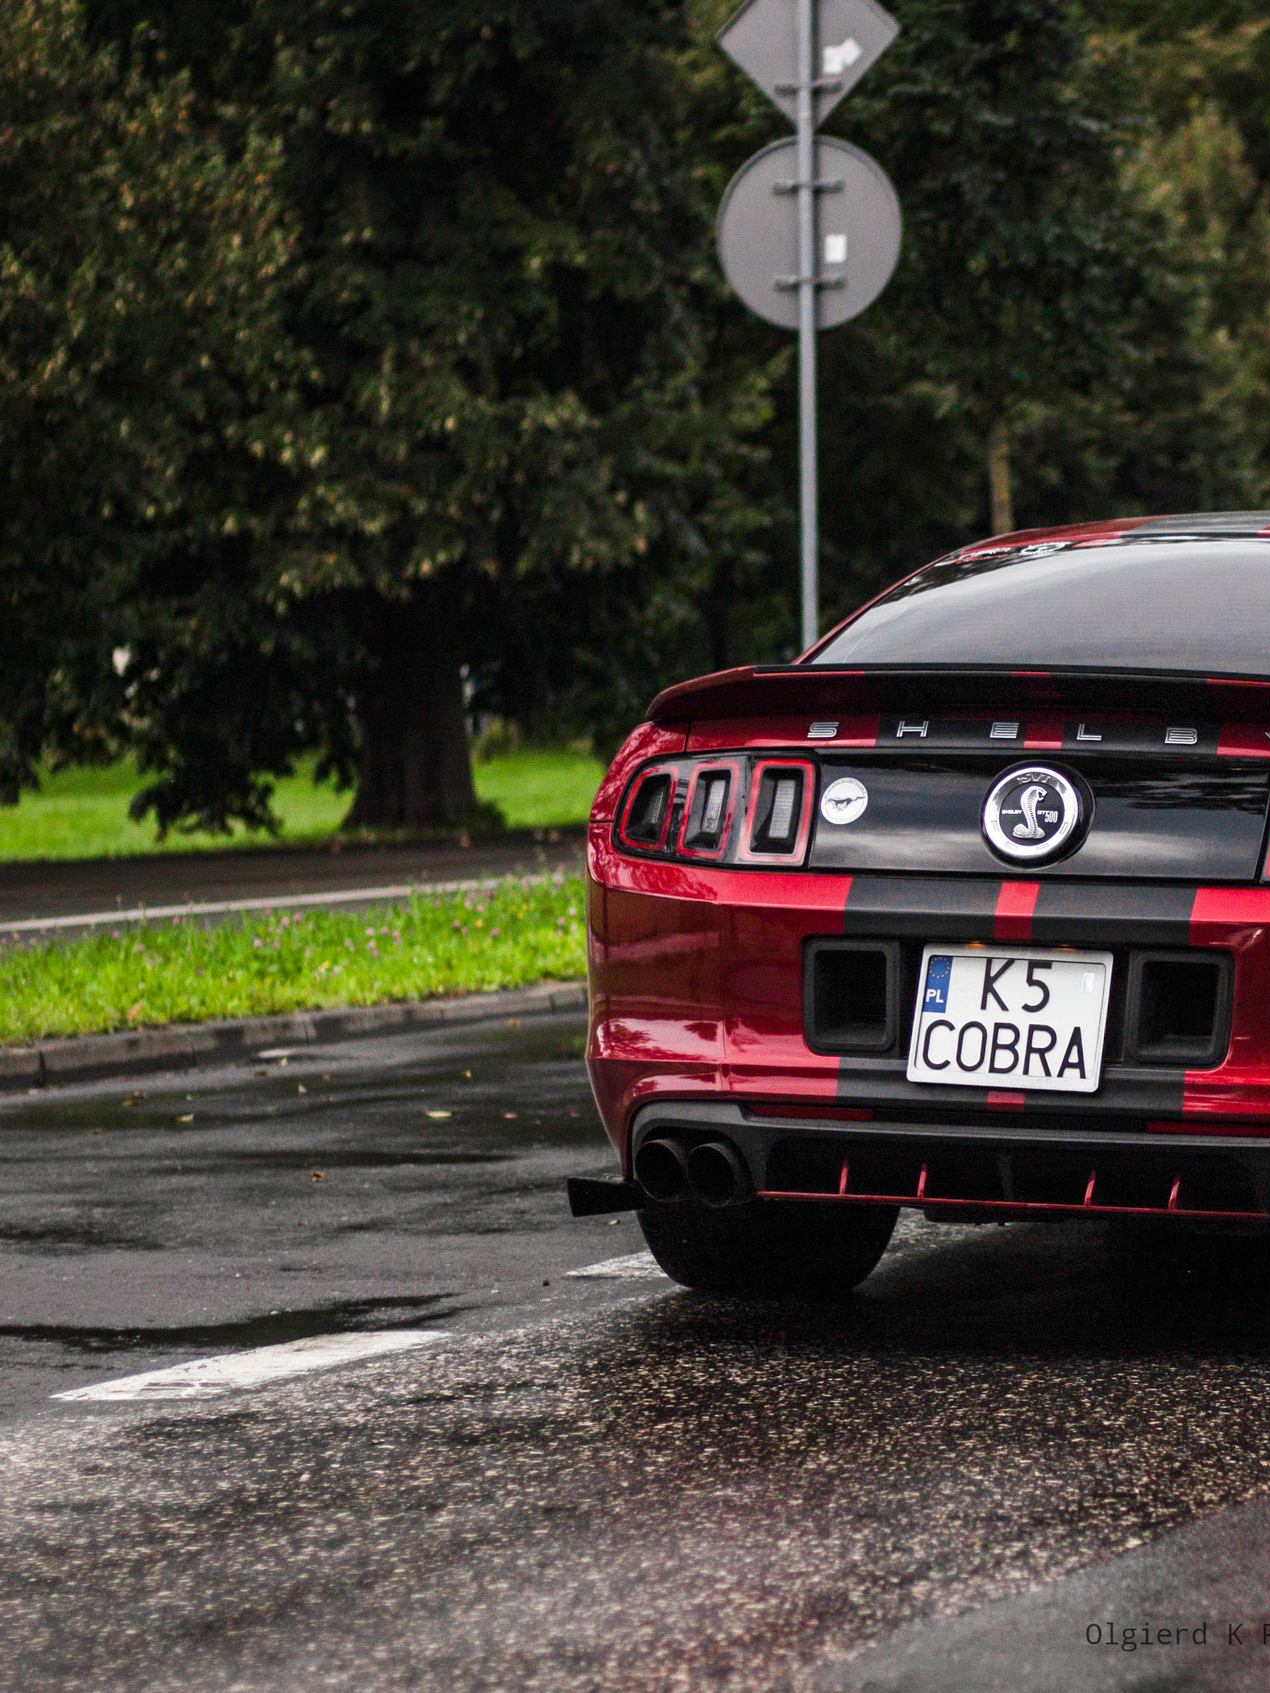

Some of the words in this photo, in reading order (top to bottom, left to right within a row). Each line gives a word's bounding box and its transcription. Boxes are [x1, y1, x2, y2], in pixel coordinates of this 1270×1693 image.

[925, 988, 944, 1003] PL
[980, 958, 1053, 1013] K5
[922, 1019, 1087, 1079] COBRA
